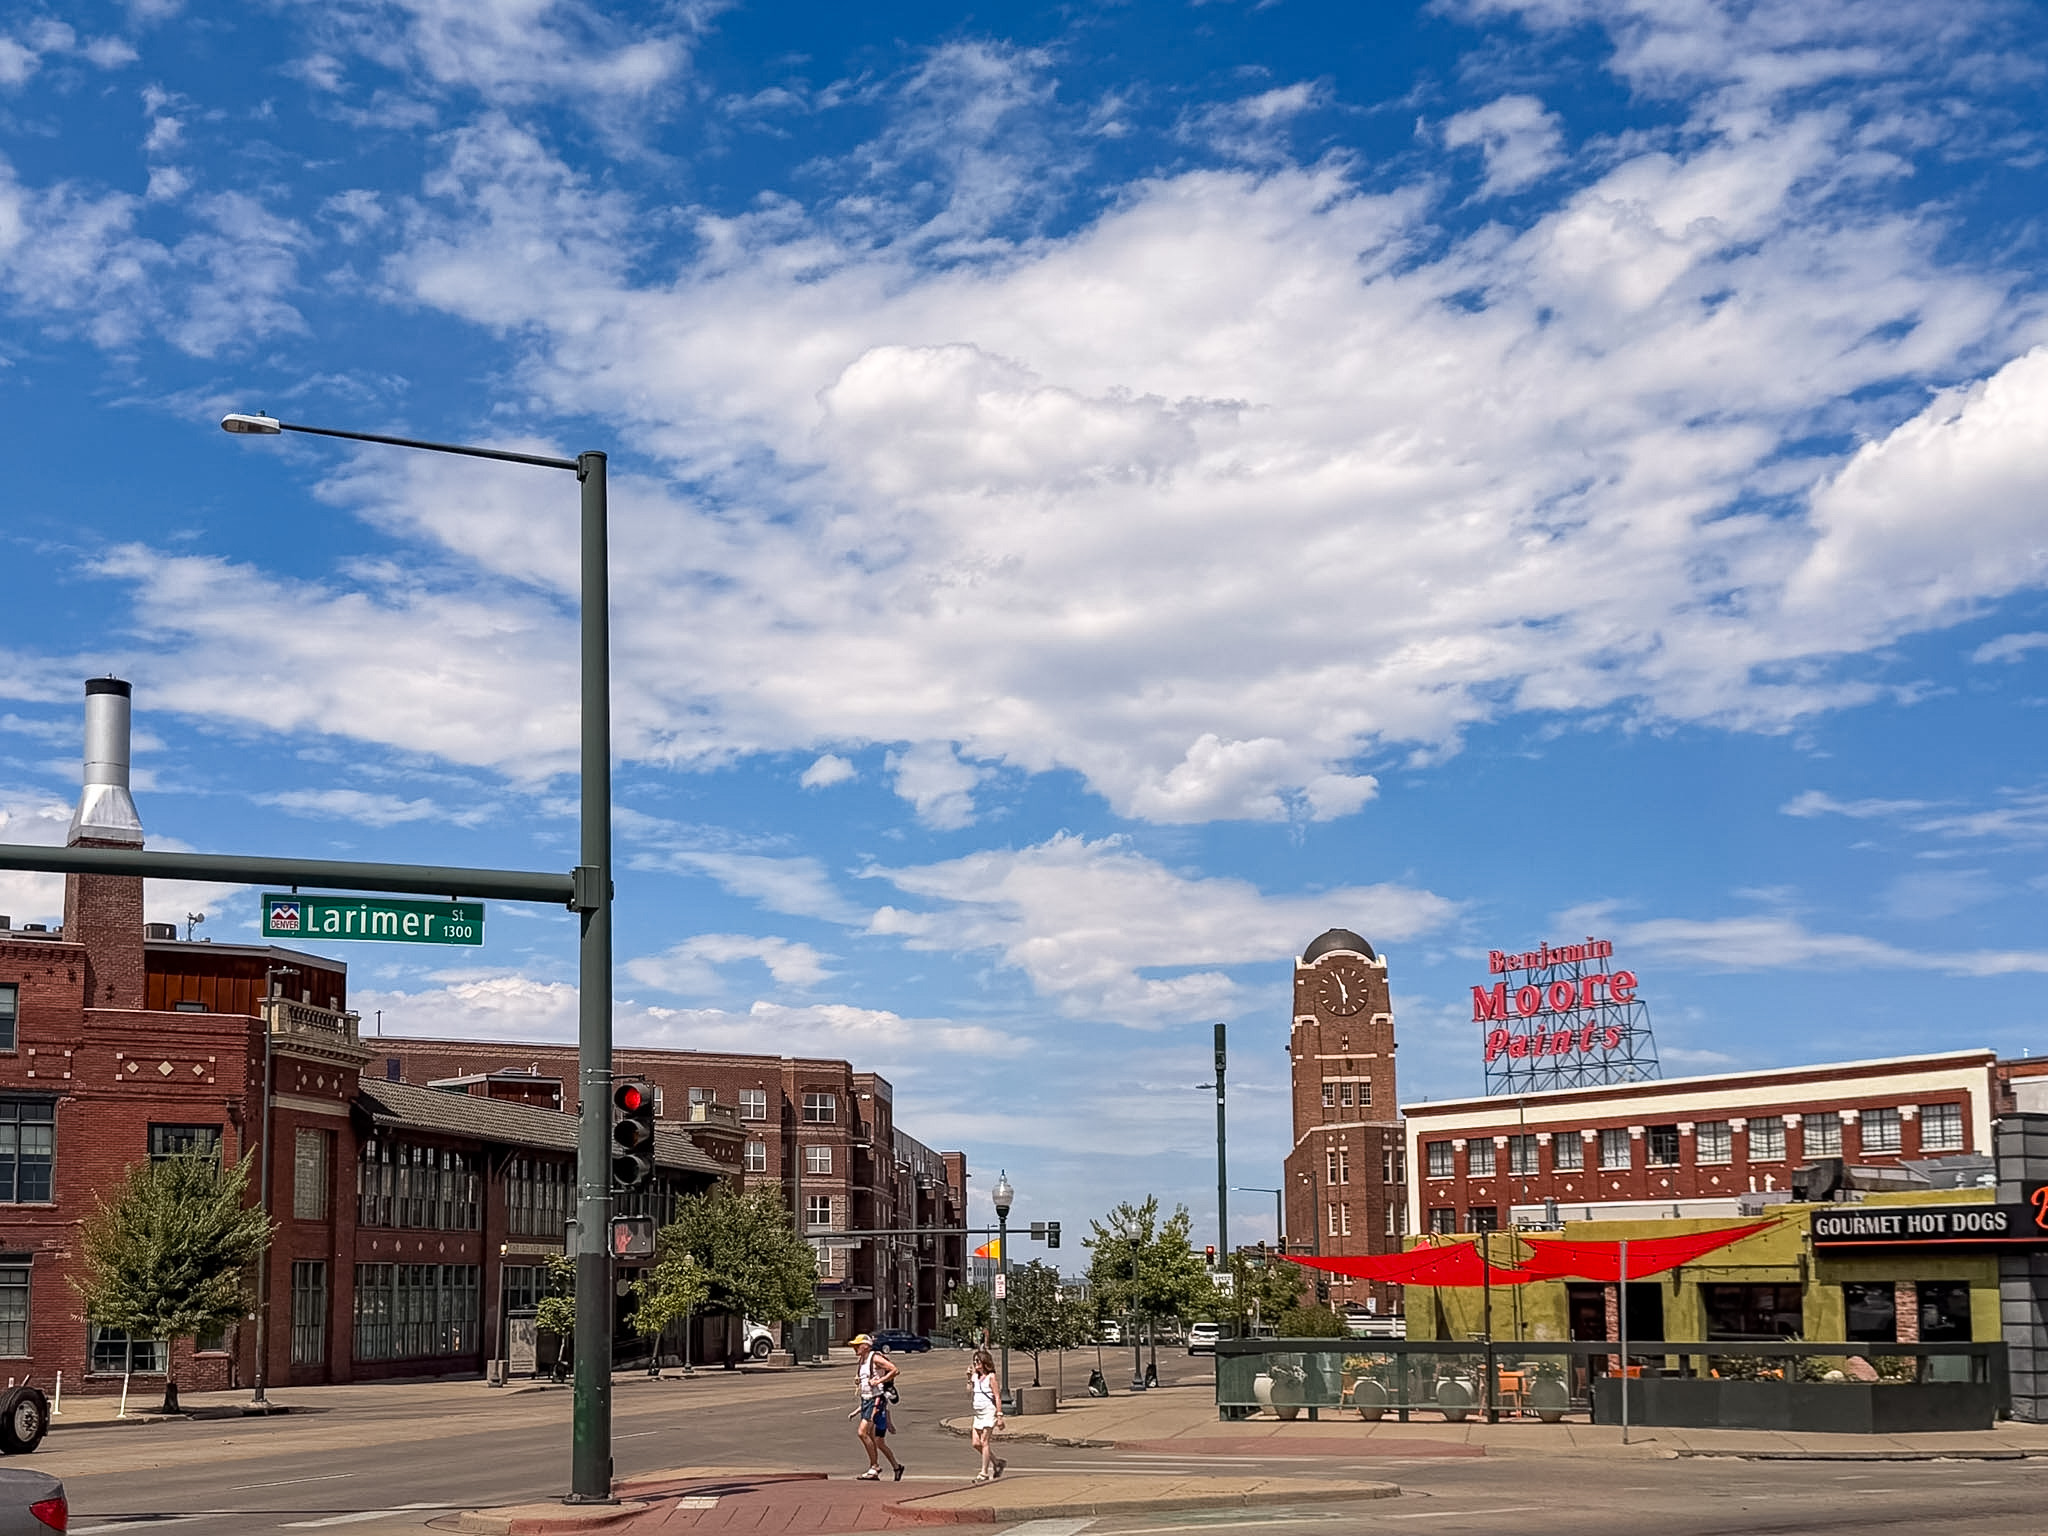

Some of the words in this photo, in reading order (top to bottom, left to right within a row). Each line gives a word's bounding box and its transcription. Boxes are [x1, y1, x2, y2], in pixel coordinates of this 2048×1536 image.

[270, 919, 299, 930] DENVER
[307, 904, 435, 937] Larimer
[452, 909, 464, 922] St
[443, 925, 472, 938] 1300
[1488, 936, 1613, 974] Benjamin
[1470, 970, 1638, 1023] Moore
[1484, 1020, 1622, 1062] Paints
[1815, 1215, 1902, 1235] GOURMET
[1907, 1213, 1947, 1233] HOT
[1952, 1211, 2008, 1232] DOGS
